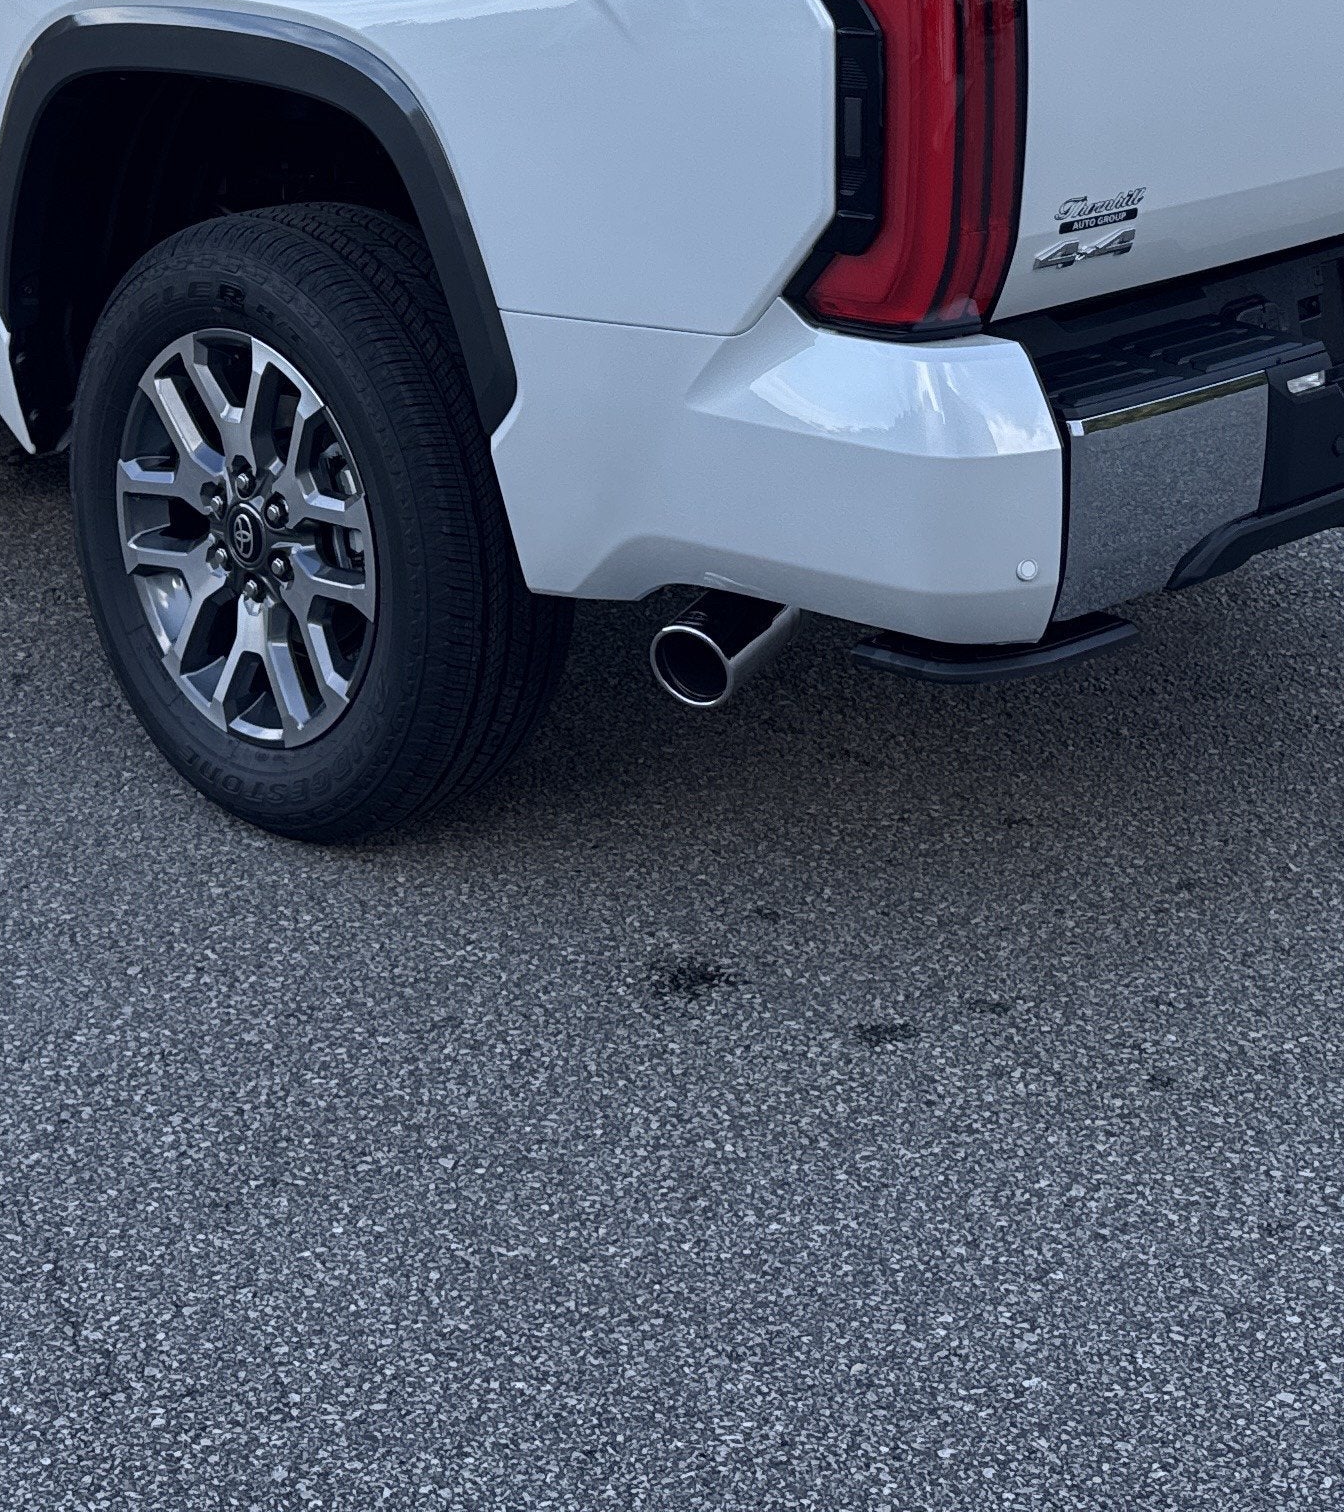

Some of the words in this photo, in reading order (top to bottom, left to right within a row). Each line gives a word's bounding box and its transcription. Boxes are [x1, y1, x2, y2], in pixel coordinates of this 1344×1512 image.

[1054, 187, 1146, 221] Thornhill
[1072, 216, 1096, 231] AUTO
[1097, 212, 1127, 226] GROUP
